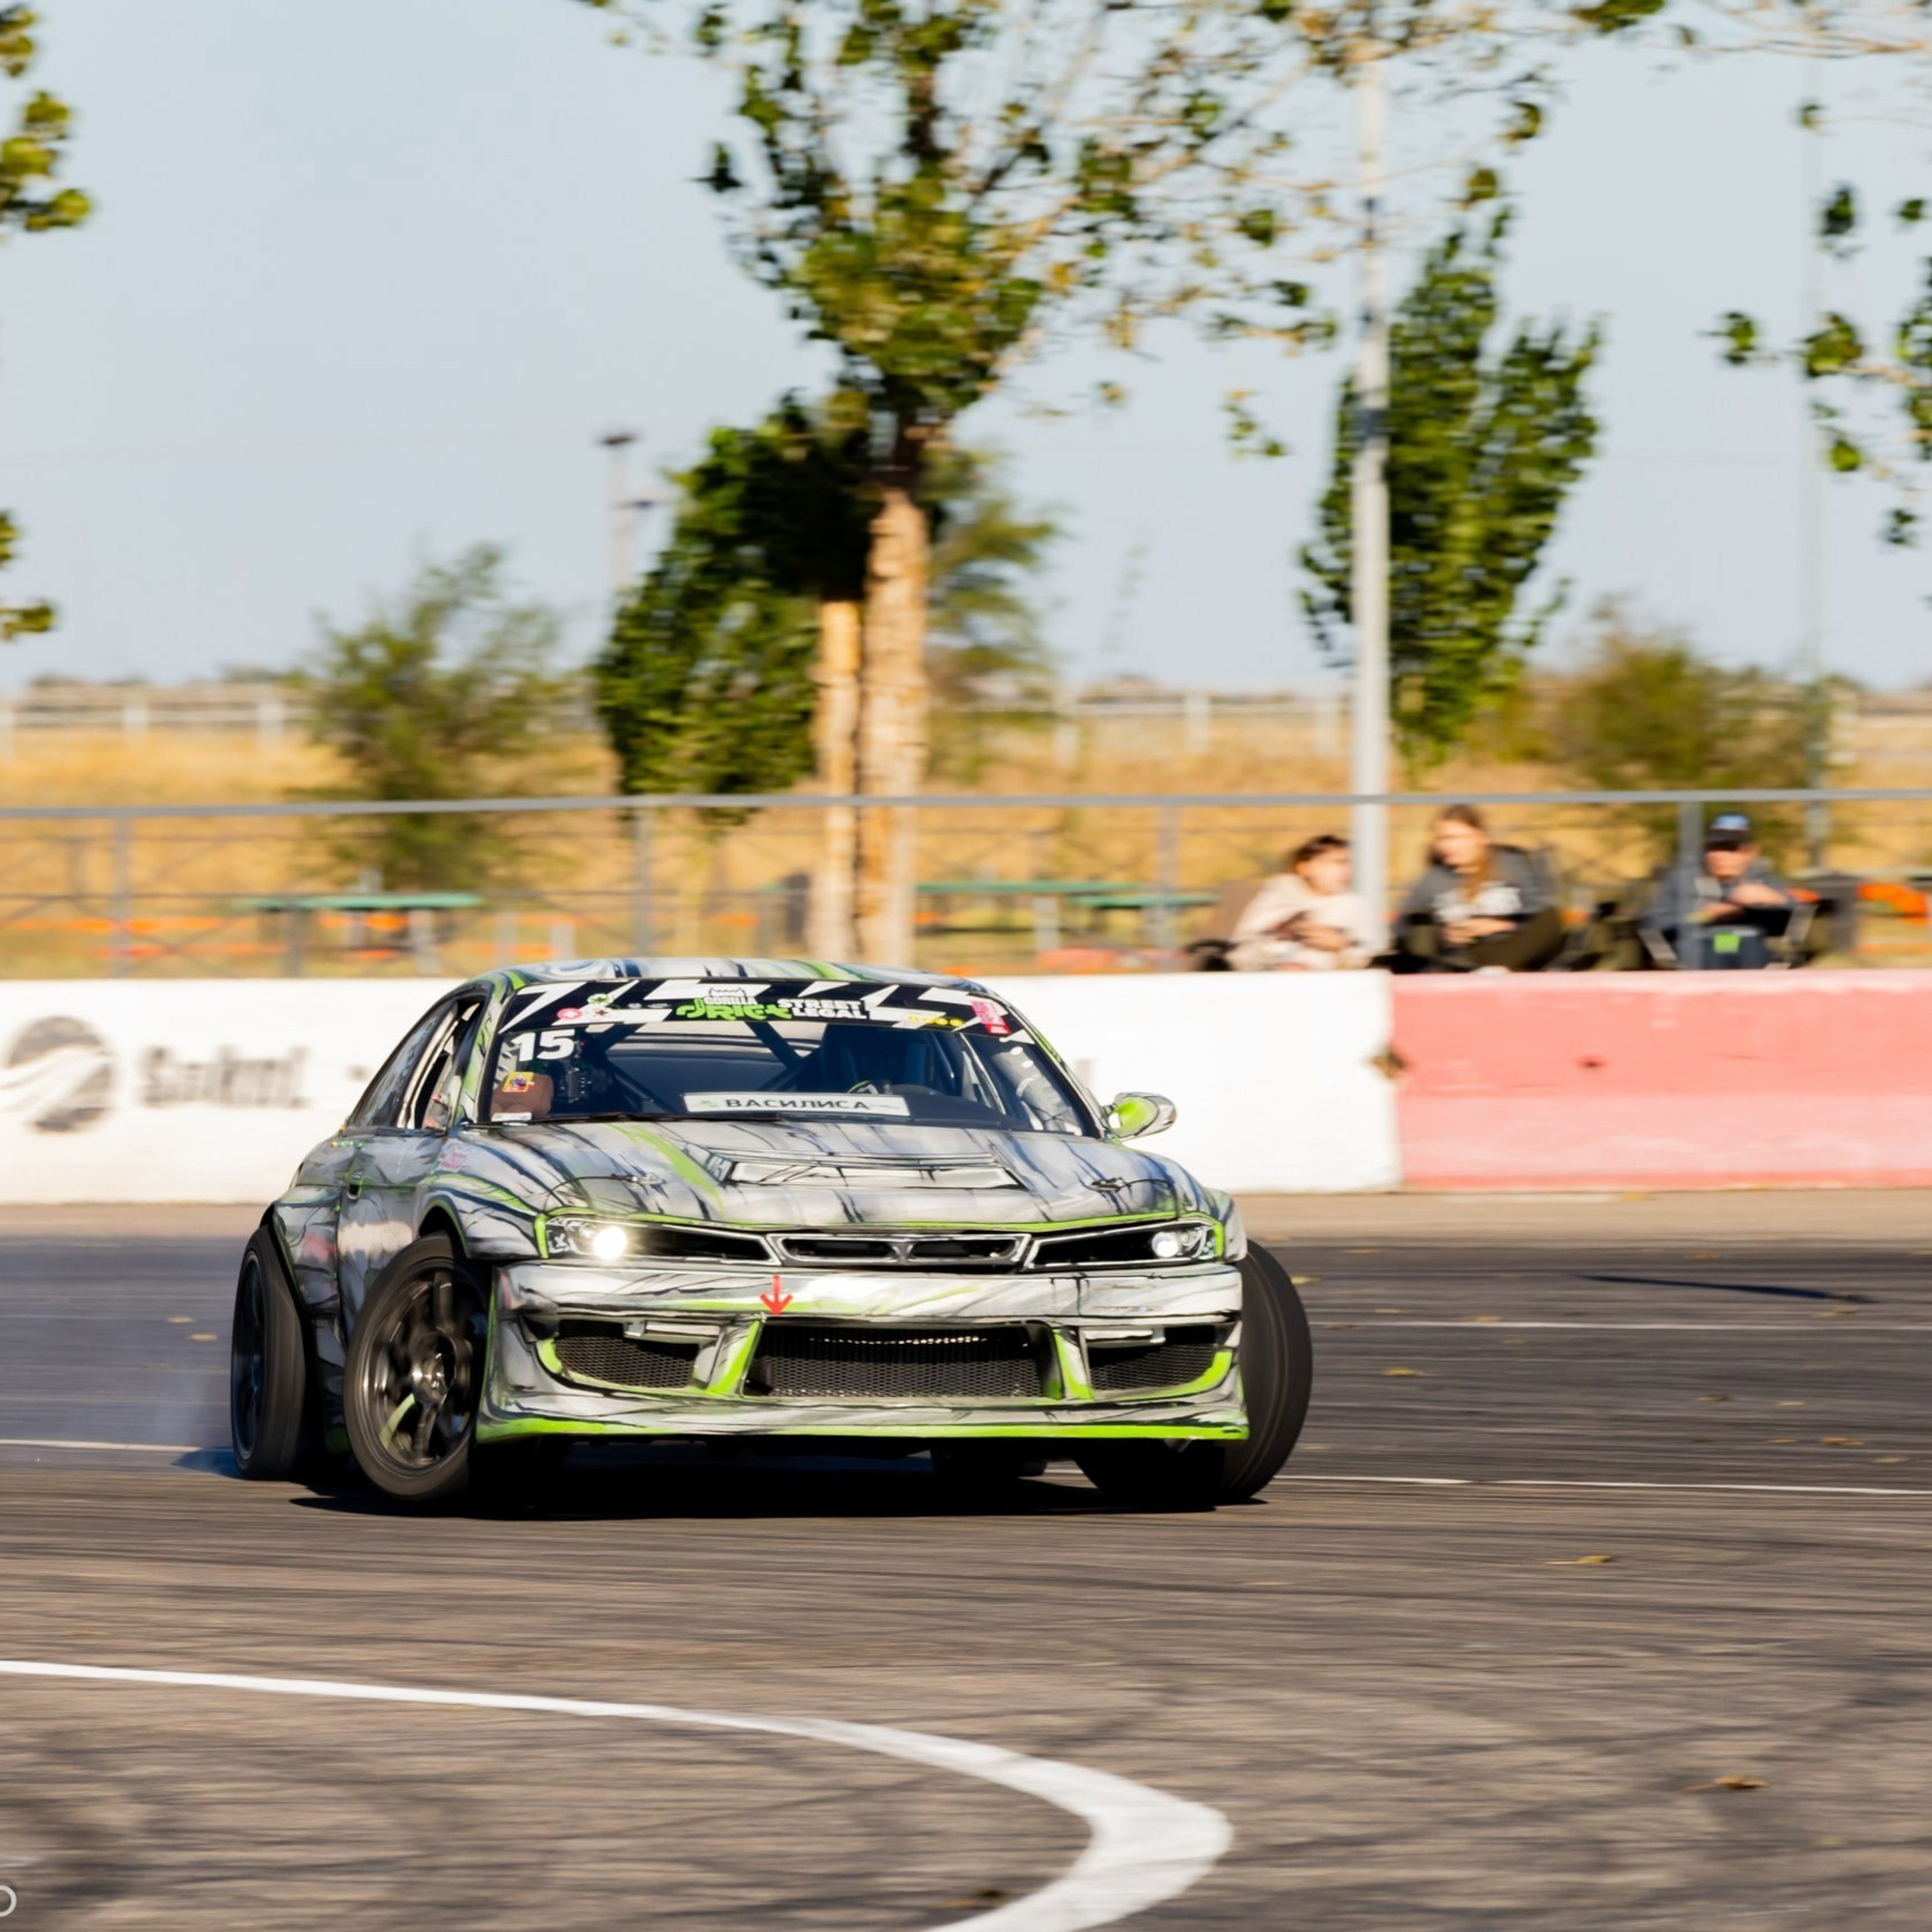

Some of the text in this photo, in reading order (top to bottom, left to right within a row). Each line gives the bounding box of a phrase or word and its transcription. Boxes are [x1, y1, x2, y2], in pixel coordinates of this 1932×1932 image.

[778, 998, 862, 1009] STREET
[793, 1008, 867, 1019] LEGAL
[511, 1029, 576, 1062] 15
[725, 1099, 869, 1109] ВАСИЛИСА
